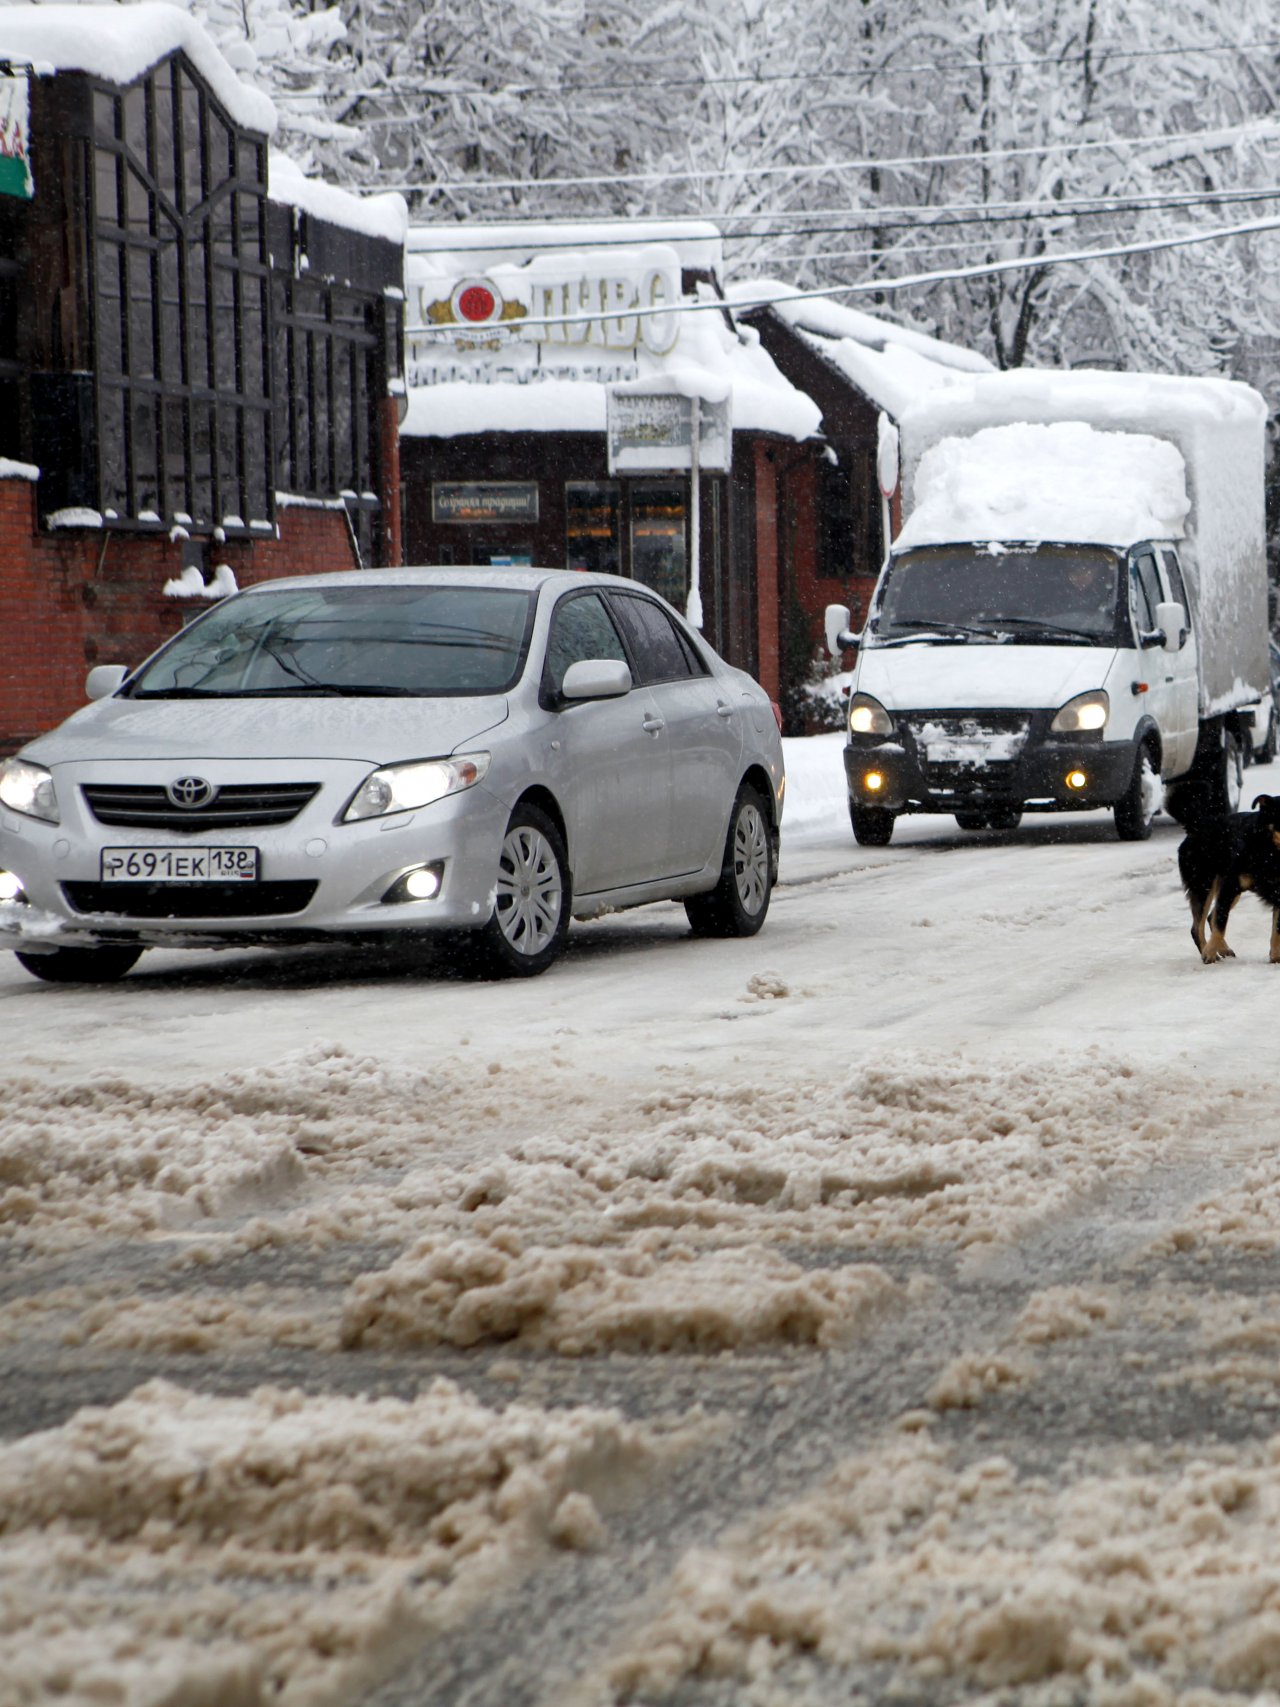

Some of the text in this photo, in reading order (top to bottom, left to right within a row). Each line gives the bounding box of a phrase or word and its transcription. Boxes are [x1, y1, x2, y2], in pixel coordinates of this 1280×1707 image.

[531, 269, 681, 356] ПИВО
[109, 851, 248, 877] Р691ЕК 138
